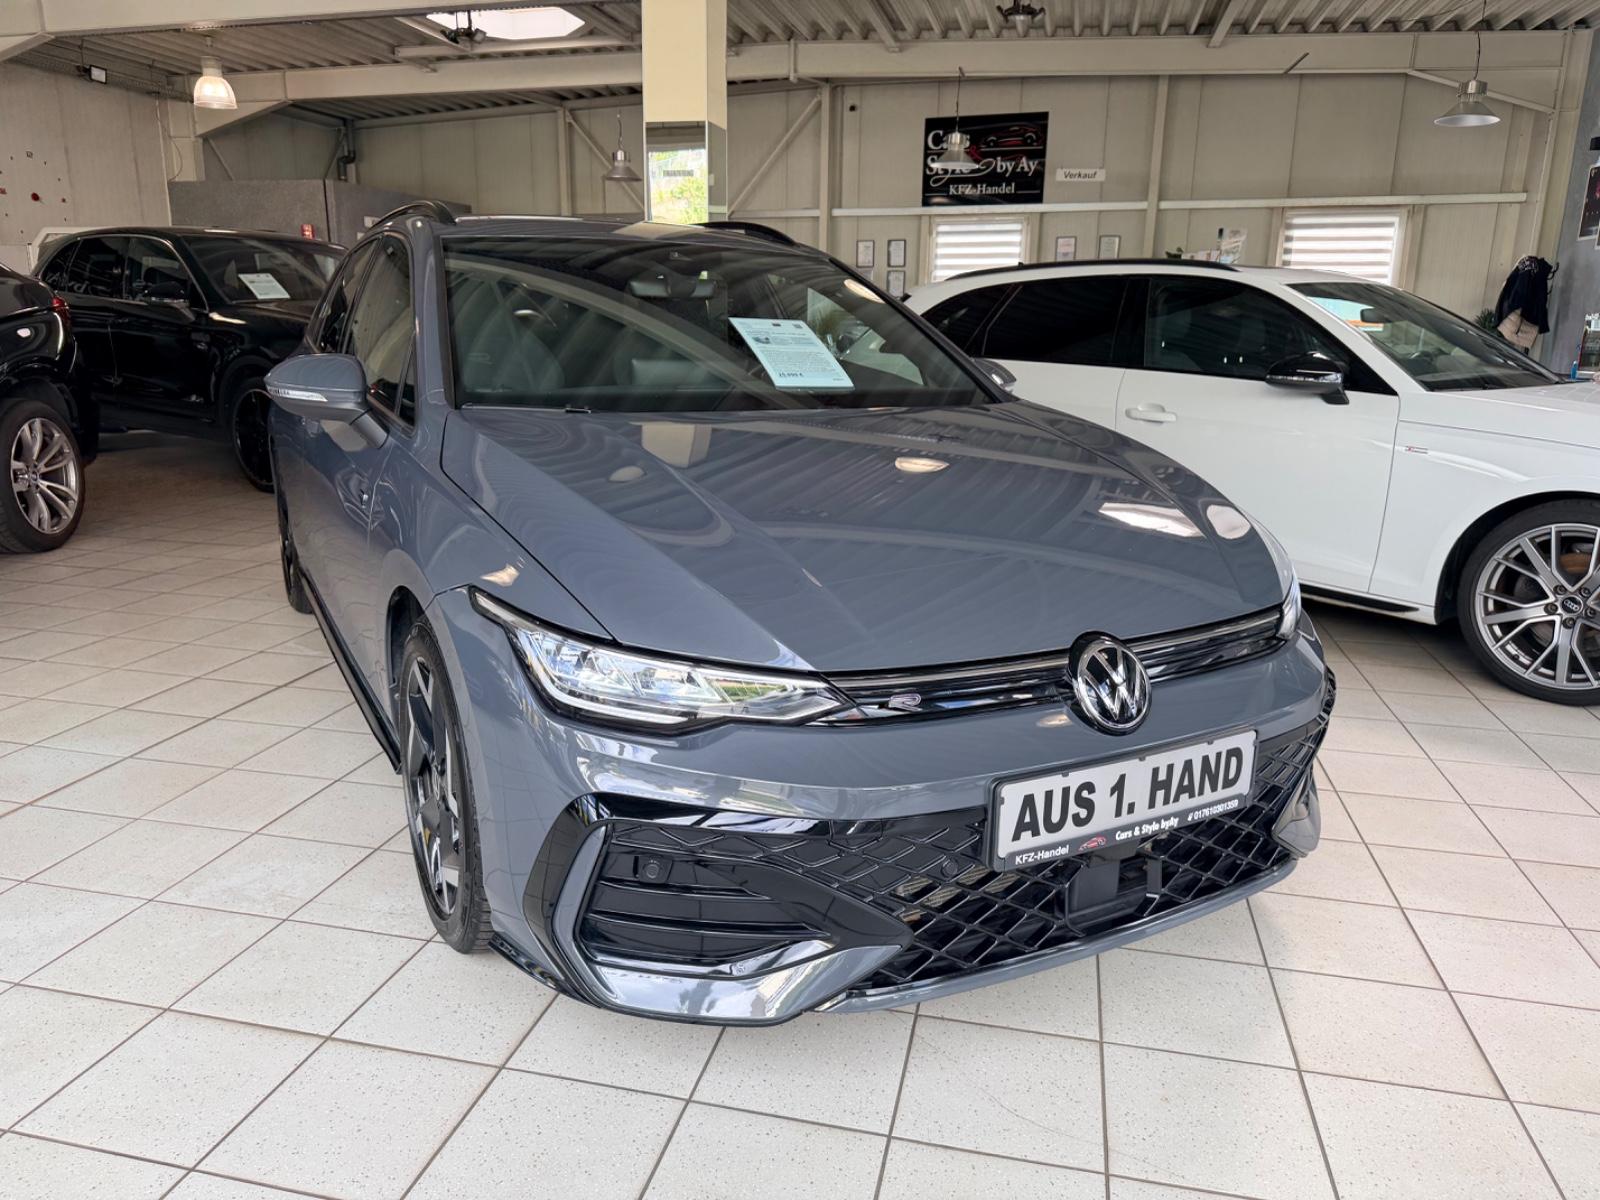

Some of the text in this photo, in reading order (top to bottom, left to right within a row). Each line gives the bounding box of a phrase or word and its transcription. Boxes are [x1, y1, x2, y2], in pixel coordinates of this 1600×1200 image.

[996, 157, 1016, 178] by
[1016, 156, 1039, 177] Ay
[1063, 170, 1098, 179] Verkauf
[949, 182, 1016, 196] KFZ-Handel
[1011, 746, 1244, 843] AUS 1. HAND
[1014, 844, 1070, 866] KFZ-Handel
[1115, 827, 1133, 841] Cars
[1133, 825, 1141, 836] &
